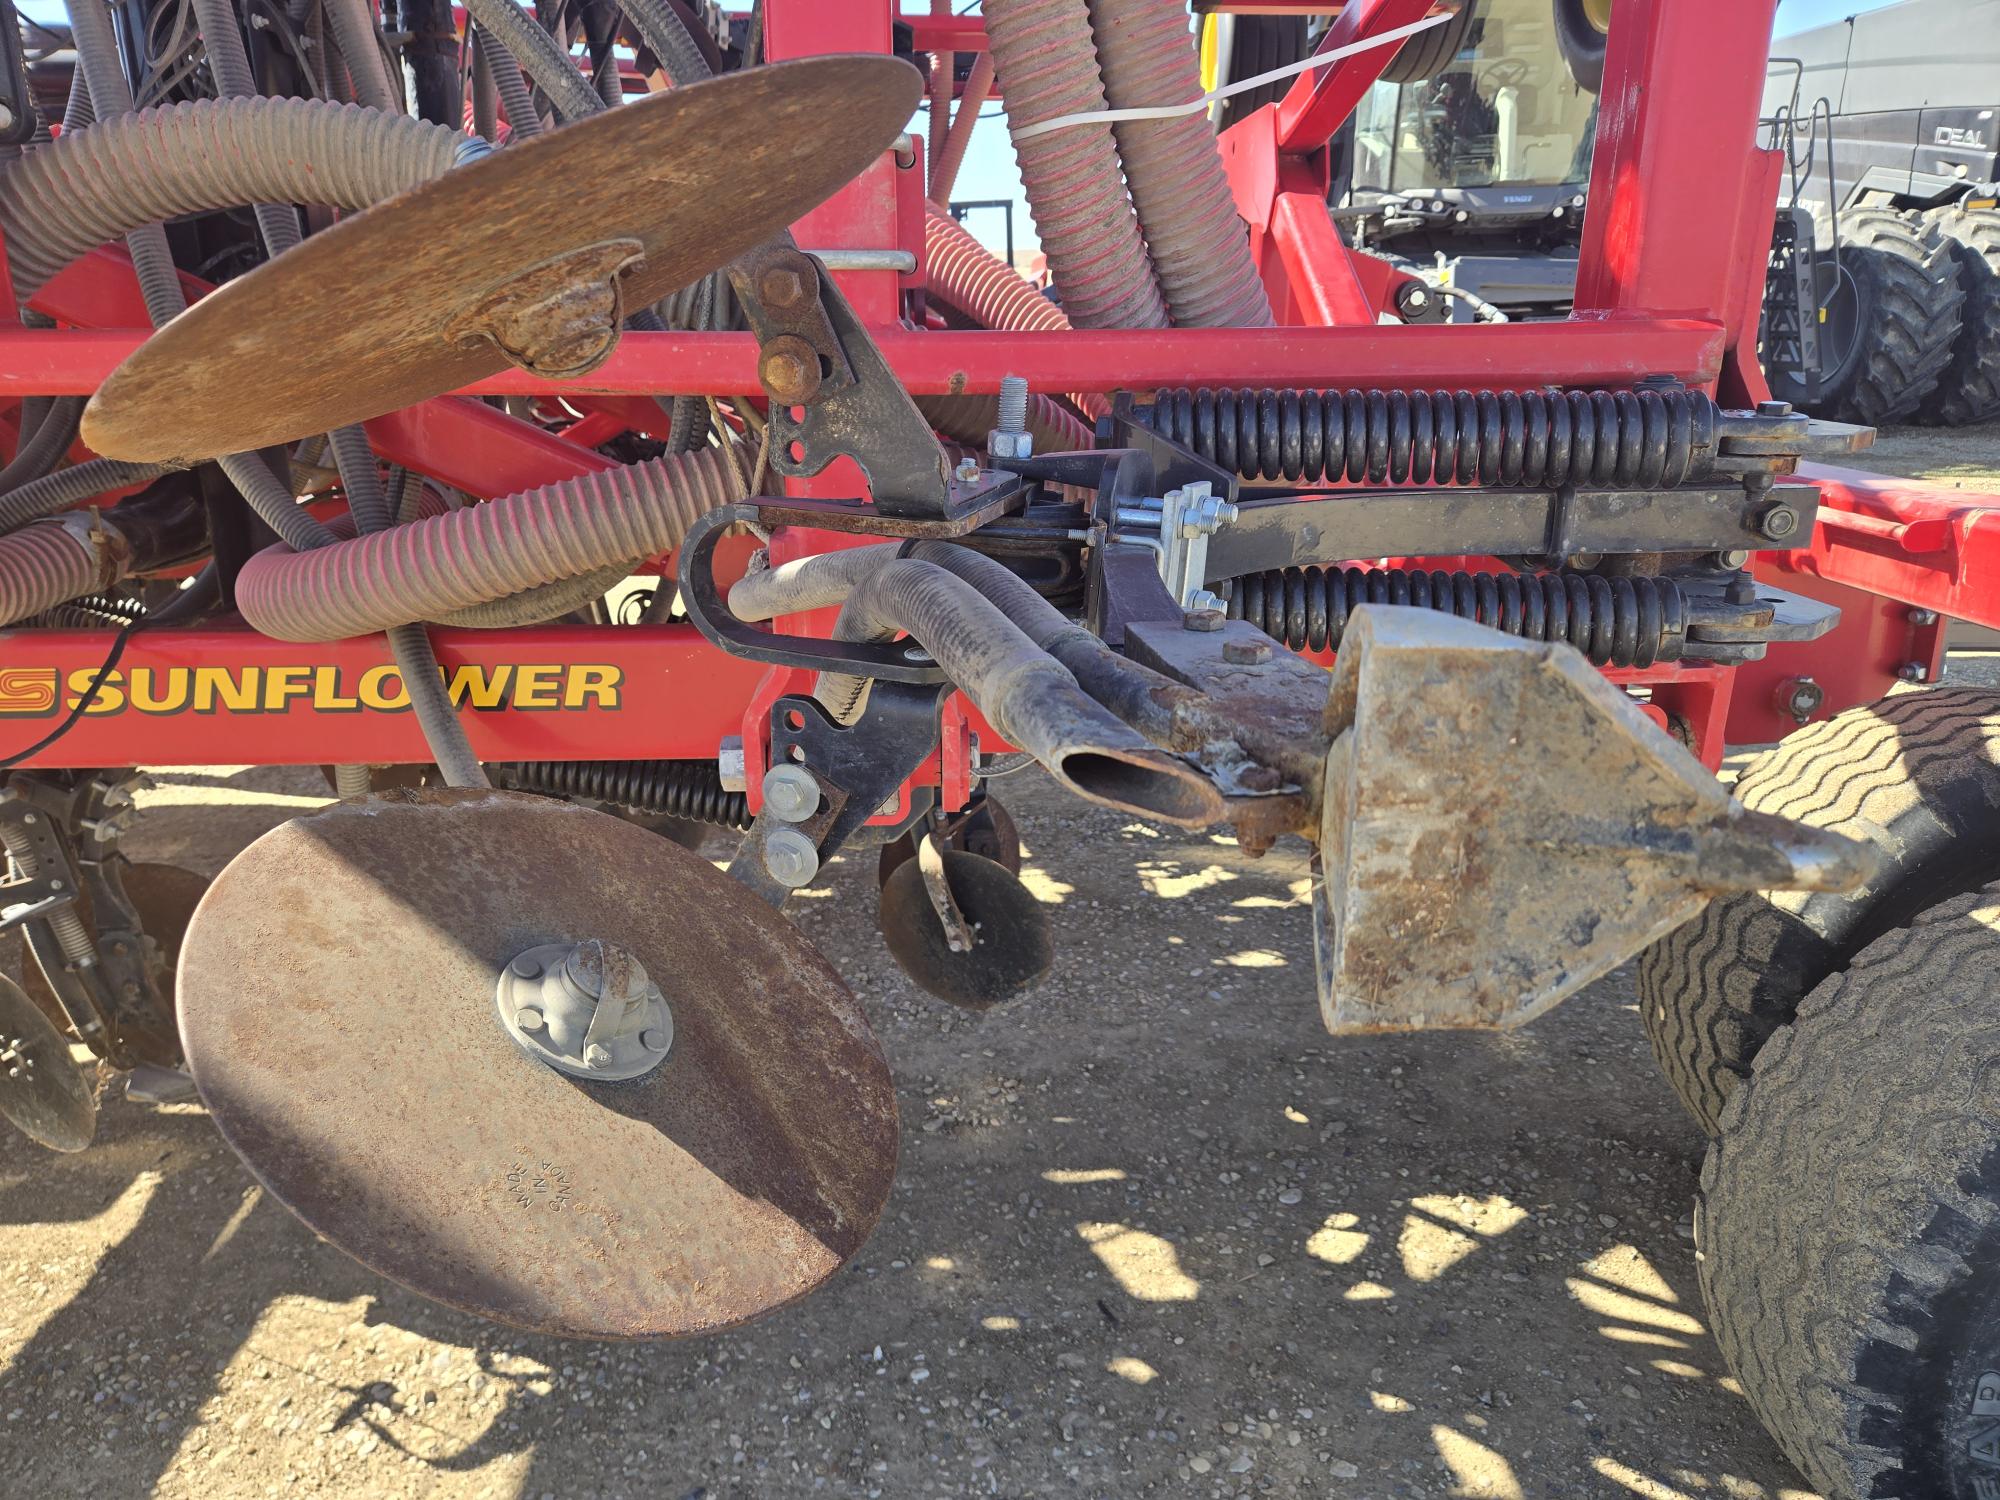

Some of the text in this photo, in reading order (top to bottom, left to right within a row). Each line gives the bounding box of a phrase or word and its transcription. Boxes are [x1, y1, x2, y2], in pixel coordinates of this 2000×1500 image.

[1934, 126, 1987, 149] IDEAL
[66, 664, 625, 717] SUNFLOWER
[508, 1162, 535, 1210] MADE
[532, 1178, 548, 1194] IN
[541, 1159, 573, 1213] CANADA
